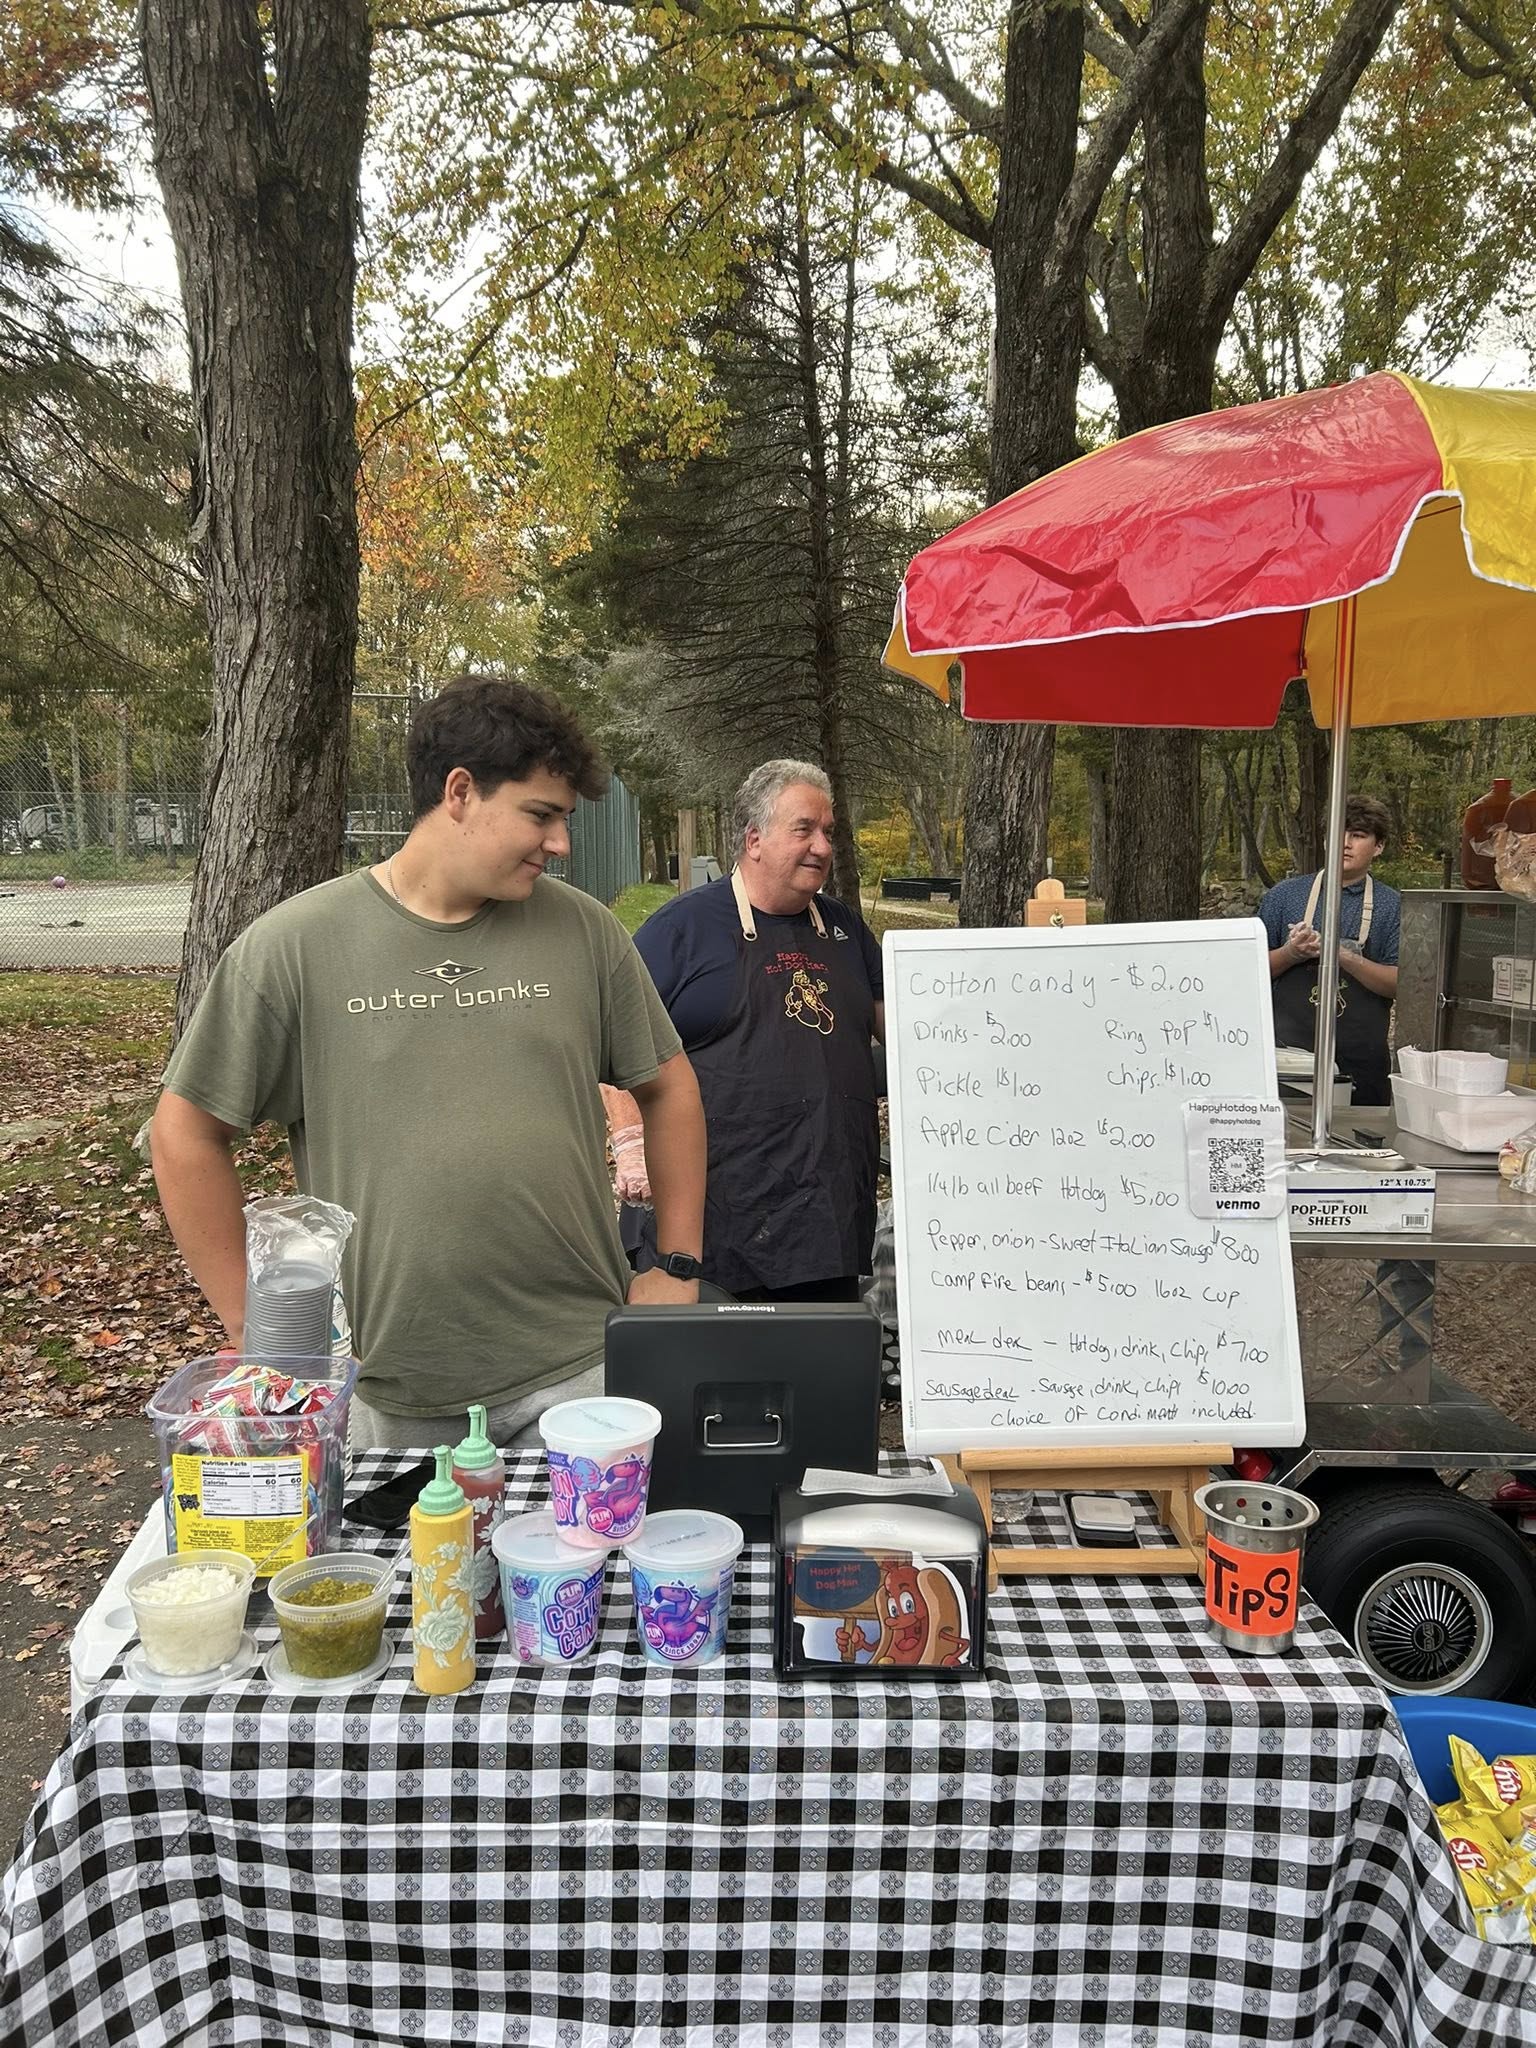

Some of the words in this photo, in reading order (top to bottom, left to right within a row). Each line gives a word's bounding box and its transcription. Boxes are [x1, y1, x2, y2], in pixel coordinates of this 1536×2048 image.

[910, 971, 996, 998] Cotton
[1011, 969, 1096, 1008] Candy
[1126, 962, 1204, 993] $2.00
[347, 988, 444, 1014] outer
[454, 979, 550, 1008] banks
[1105, 1019, 1147, 1054] Ring
[916, 1066, 984, 1098] Pickle
[1260, 1103, 1281, 1113] Man
[1209, 1117, 1261, 1126] @happyhotdog
[920, 1115, 980, 1147] Apple
[986, 1121, 1040, 1147] Cider
[976, 1176, 999, 1196] all
[1216, 1200, 1260, 1210] venmo
[1291, 1205, 1339, 1215] POP-UP
[1342, 1205, 1368, 1215] FOIL
[1308, 1216, 1352, 1226] SHEETS
[589, 1510, 612, 1525] FUN
[810, 1567, 841, 1576] Happy
[815, 1581, 836, 1589] Dog
[560, 1584, 582, 1600] FUN
[664, 1646, 685, 1655] SINCE
